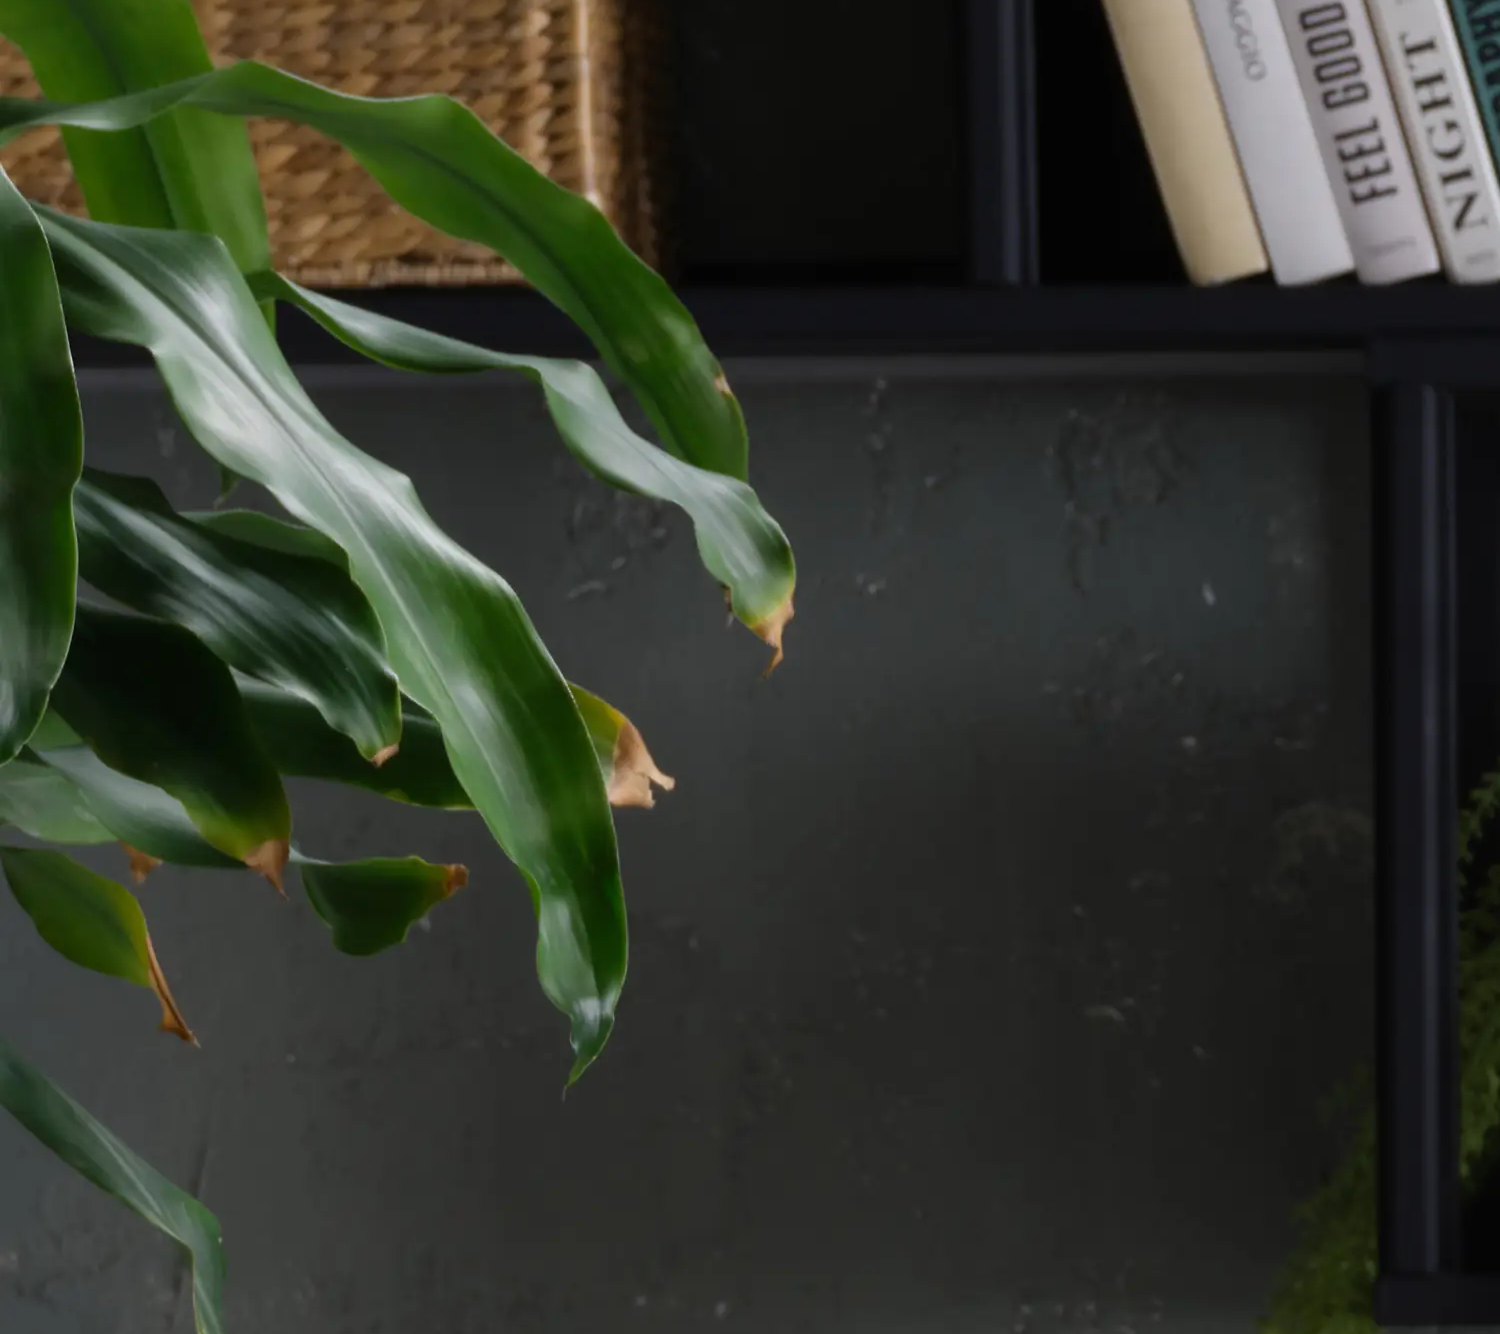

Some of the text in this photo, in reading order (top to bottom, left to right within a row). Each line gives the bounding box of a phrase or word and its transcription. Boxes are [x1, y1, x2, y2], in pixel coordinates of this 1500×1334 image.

[1299, 0, 1370, 110] GOOD
[1334, 116, 1398, 206] FEEL
[1400, 31, 1489, 233] NIGHT
